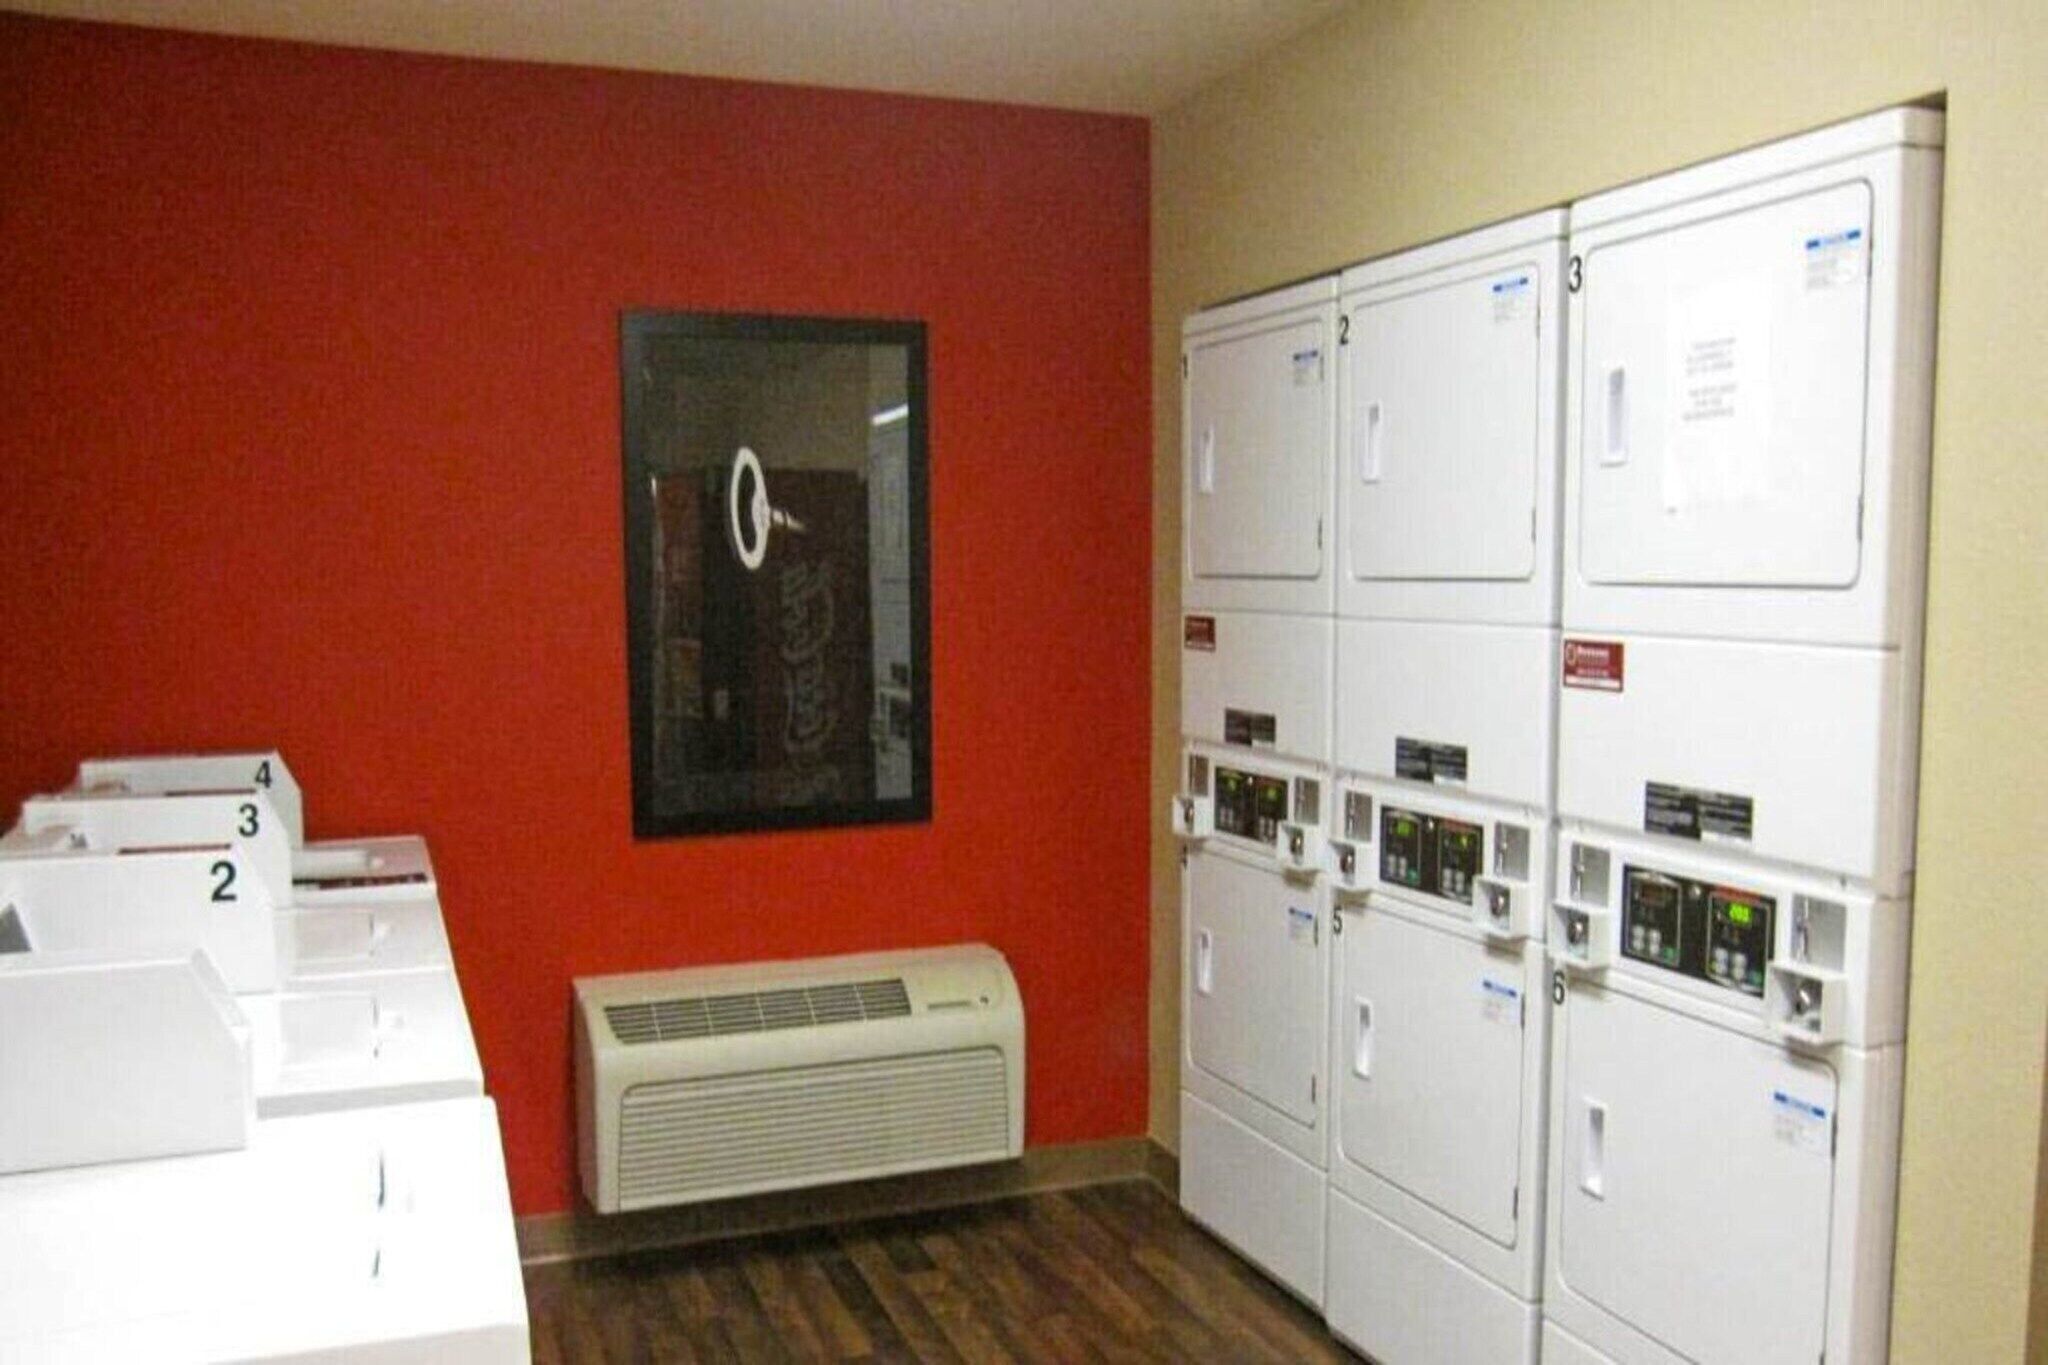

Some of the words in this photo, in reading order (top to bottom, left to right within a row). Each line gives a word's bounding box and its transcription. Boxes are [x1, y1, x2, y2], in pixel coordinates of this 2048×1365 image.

[1568, 255, 1583, 293] 3
[1339, 315, 1350, 346] 2
[254, 760, 273, 789] 4
[238, 803, 260, 837] 3
[210, 860, 237, 902] 2
[1332, 907, 1343, 935] 5
[1552, 970, 1566, 1006] 6
